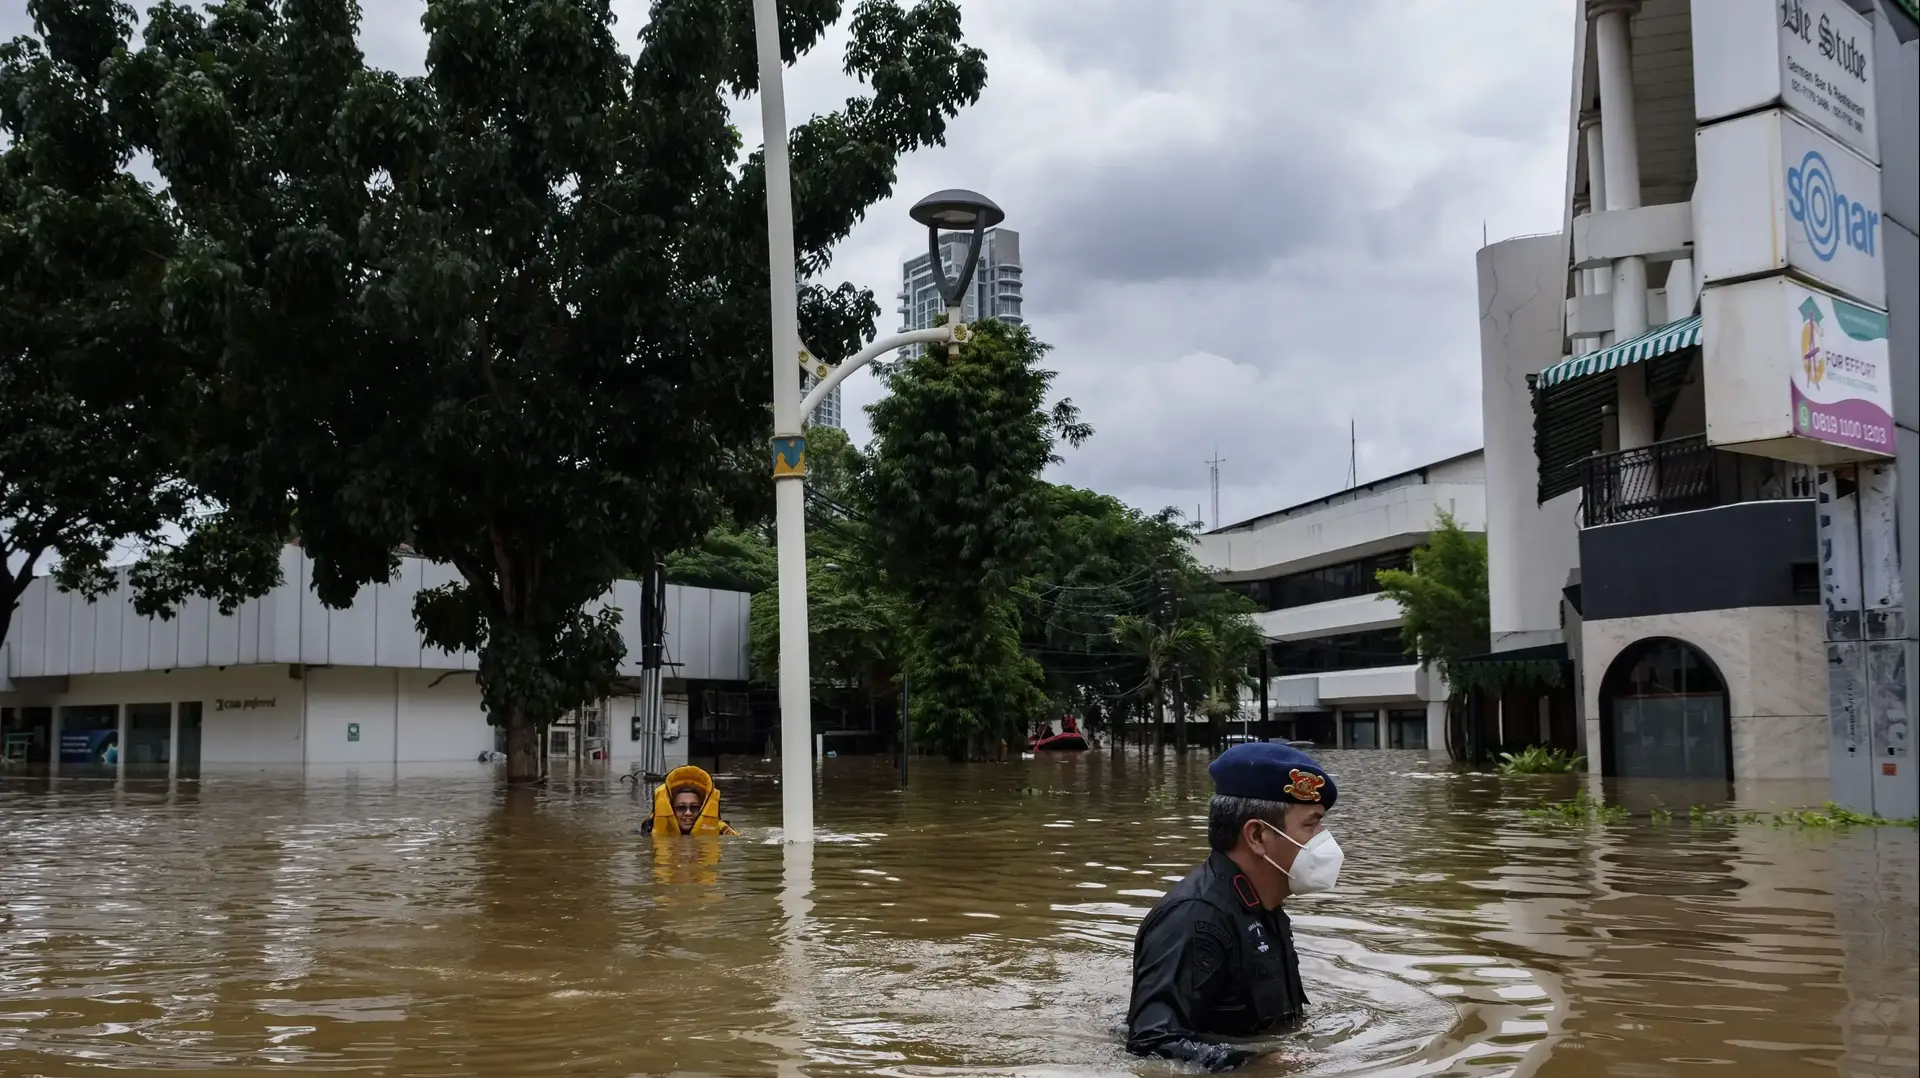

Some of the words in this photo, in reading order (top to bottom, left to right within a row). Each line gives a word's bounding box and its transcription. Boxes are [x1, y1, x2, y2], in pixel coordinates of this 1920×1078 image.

[1818, 12, 1867, 83] Stube
[1786, 55, 1814, 83] German
[1814, 73, 1826, 90] Bar
[1833, 85, 1865, 118] Restaurant
[1787, 150, 1878, 262] sonar
[1825, 350, 1844, 369] FOR
[1845, 356, 1876, 378] EFFORT
[1811, 411, 1838, 434] 0819
[1839, 415, 1862, 438] 1100
[1863, 421, 1887, 444] 1203
